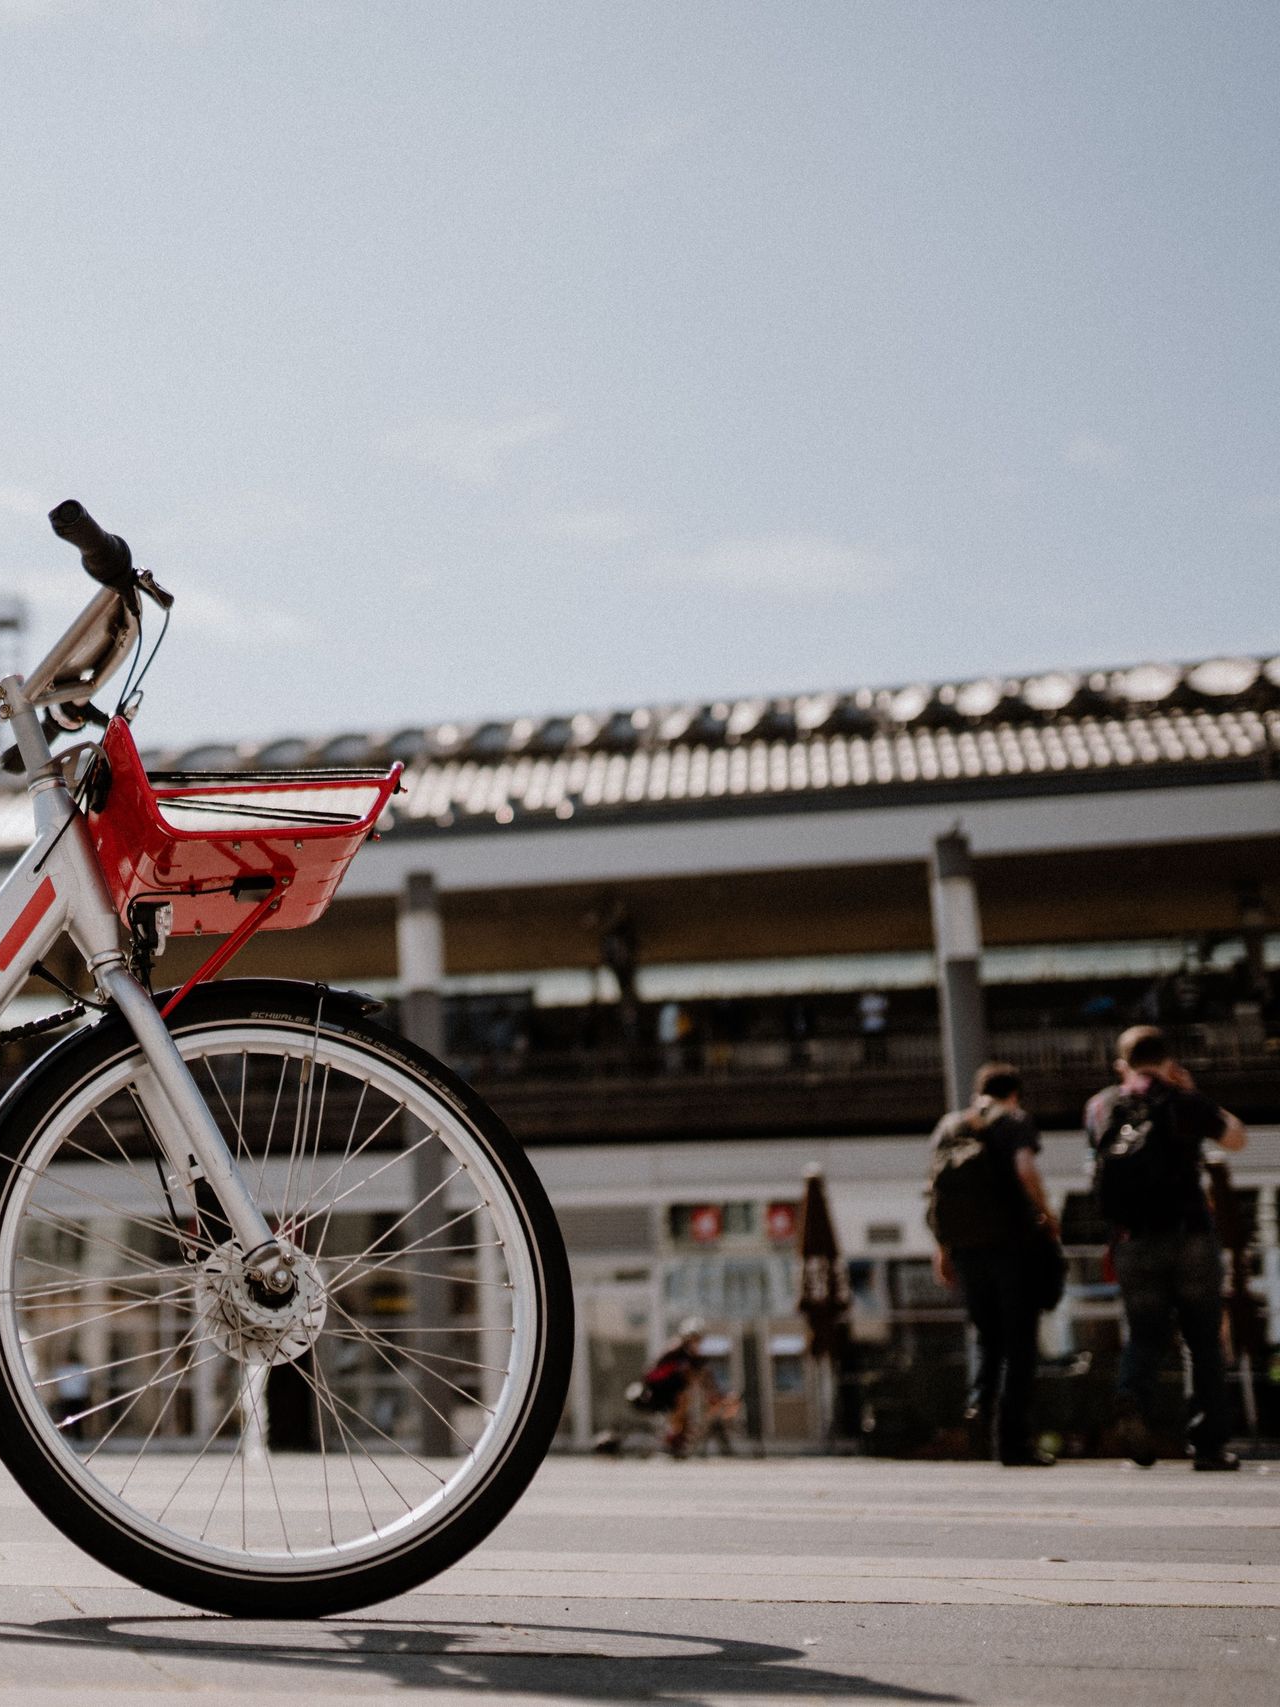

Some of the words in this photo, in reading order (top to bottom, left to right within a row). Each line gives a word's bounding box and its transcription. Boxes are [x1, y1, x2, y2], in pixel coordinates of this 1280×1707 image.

[250, 1011, 311, 1024] SCHWALBE
[346, 1030, 373, 1043] DELTA
[374, 1040, 407, 1062] CRUISER
[407, 1060, 429, 1077] PLUS
